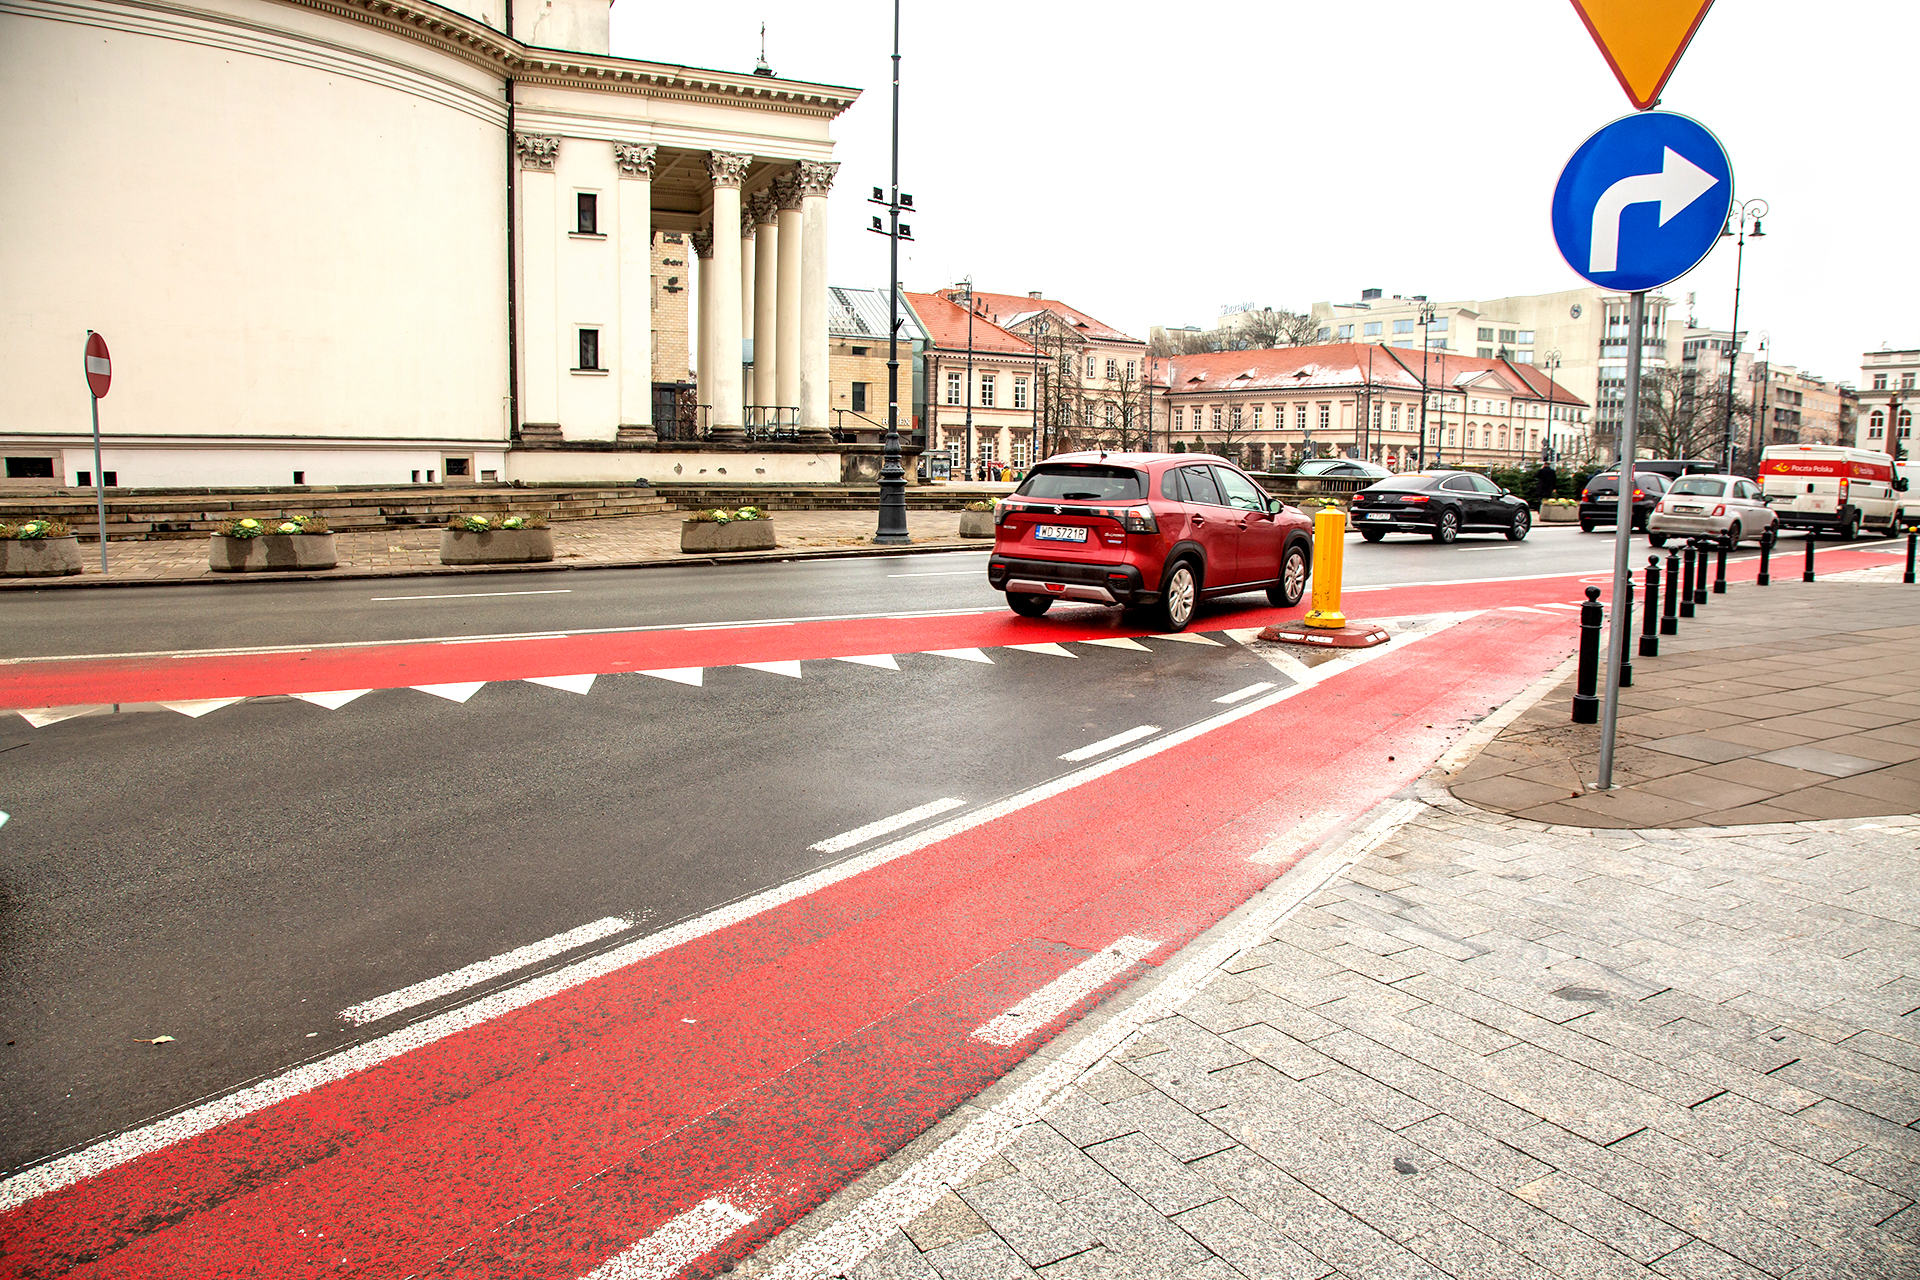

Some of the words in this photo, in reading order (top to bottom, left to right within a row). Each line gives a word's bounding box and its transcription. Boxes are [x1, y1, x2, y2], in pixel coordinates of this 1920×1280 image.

[1791, 464, 1813, 472] Poczta
[1813, 465, 1834, 473] Polska
[1041, 526, 1054, 537] WD
[1056, 527, 1085, 540] 5721R
